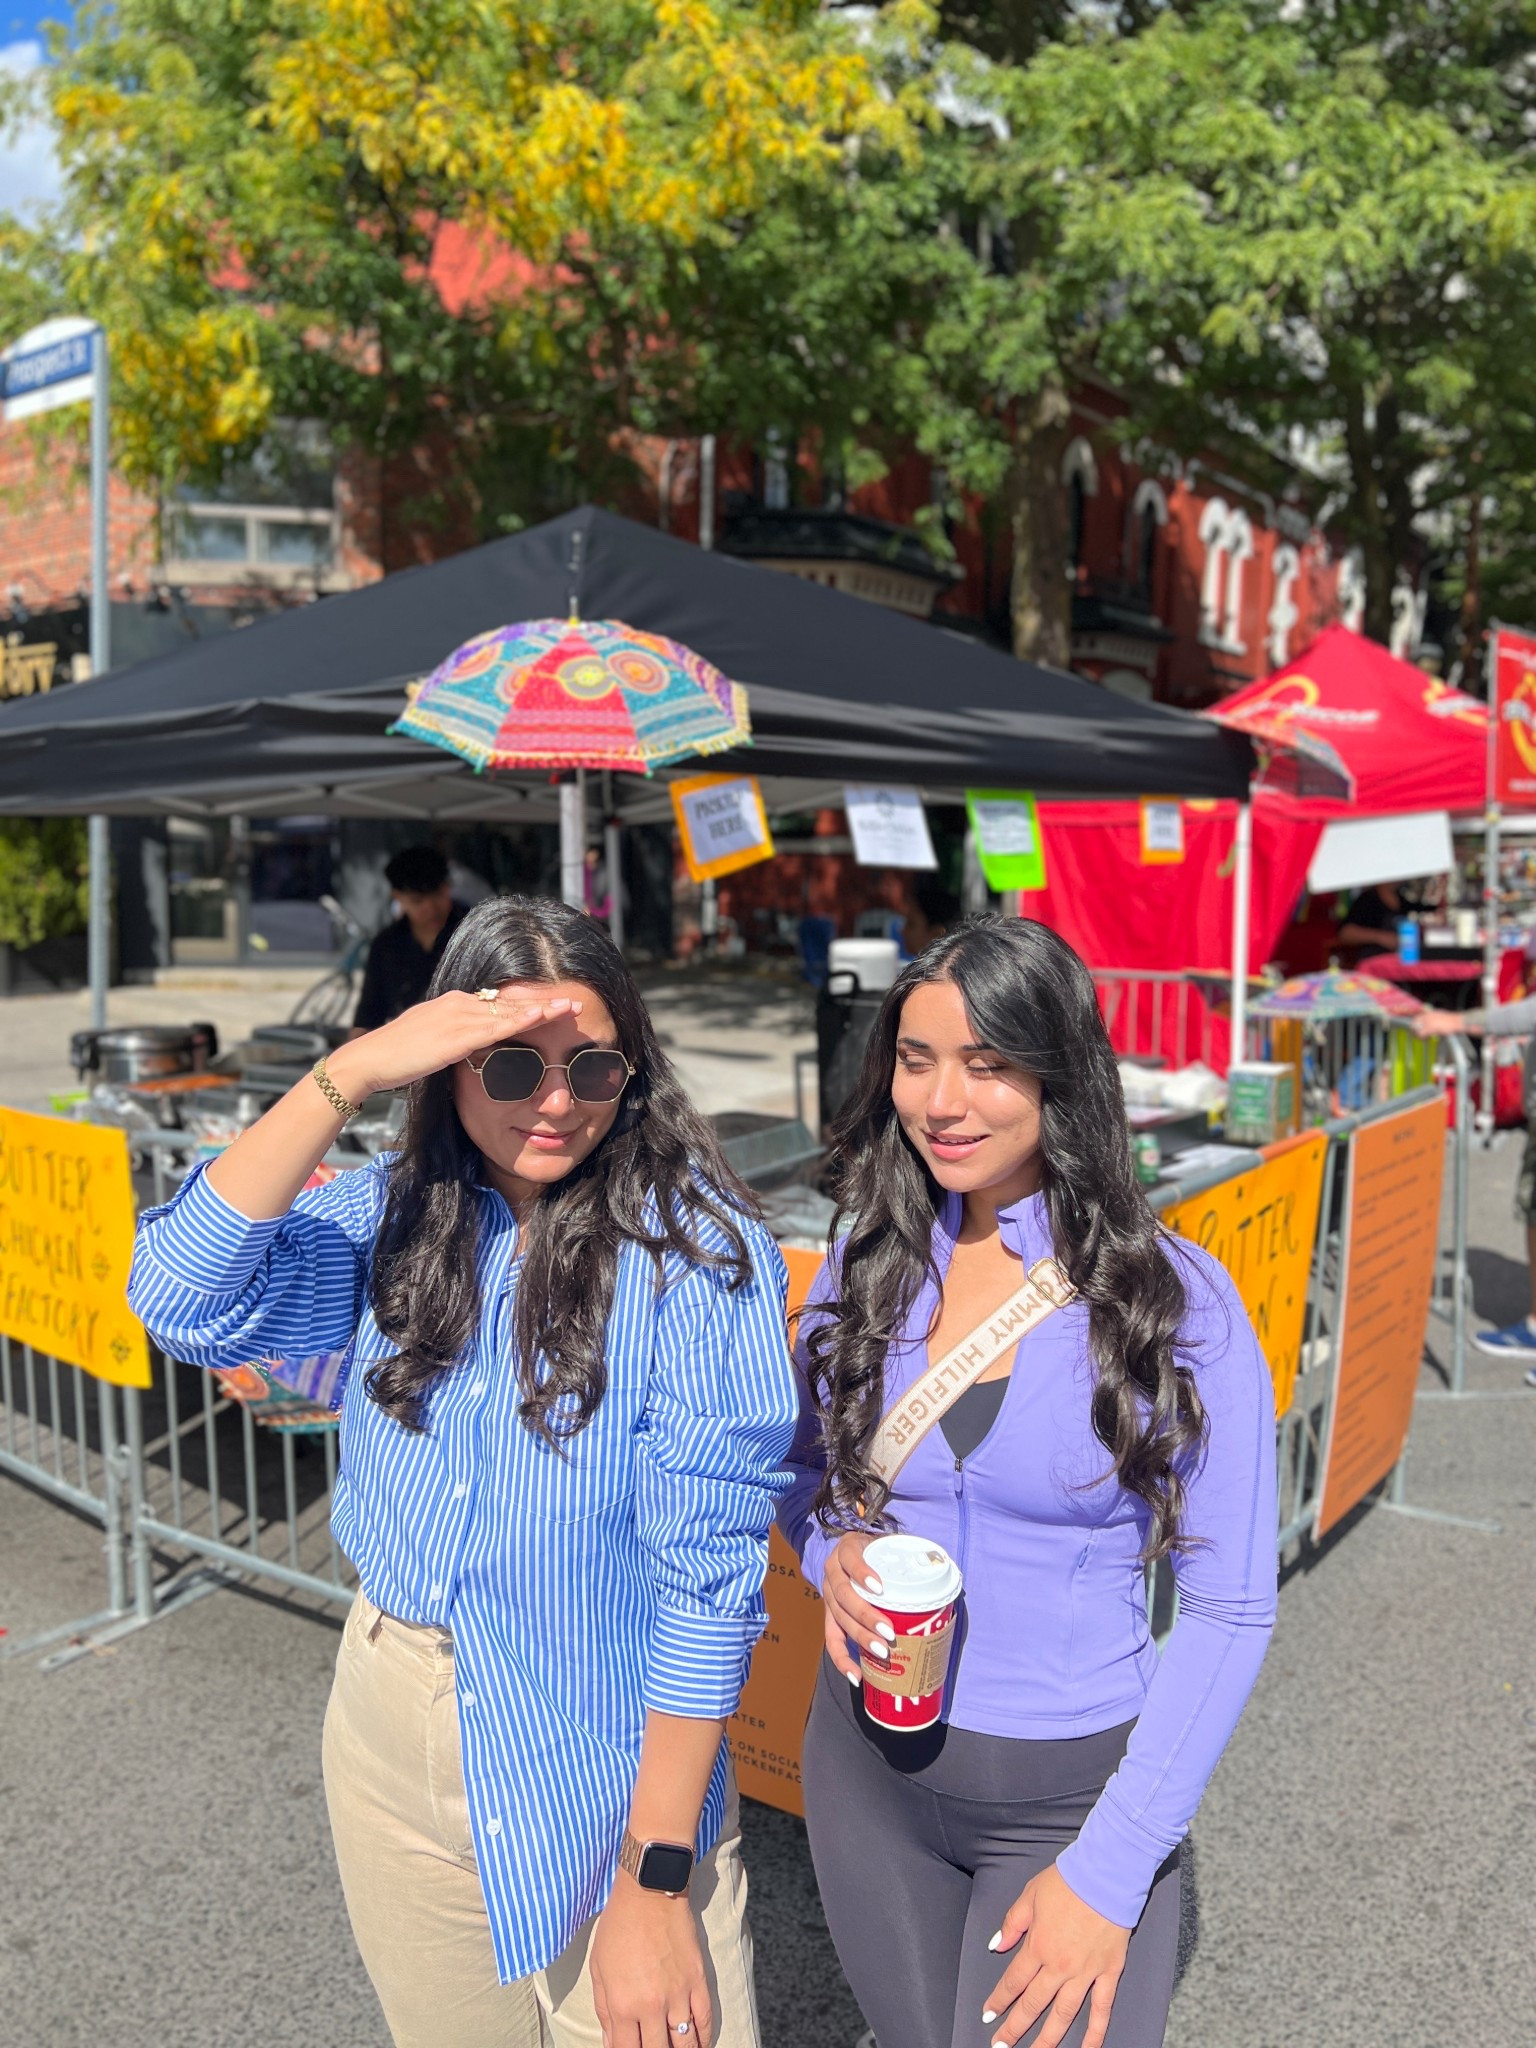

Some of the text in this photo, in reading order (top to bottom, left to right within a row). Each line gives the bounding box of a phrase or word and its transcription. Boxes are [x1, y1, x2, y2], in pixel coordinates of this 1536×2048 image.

[885, 1272, 1064, 1445] OMMY HILFIGER
[738, 1741, 755, 1753] ON
